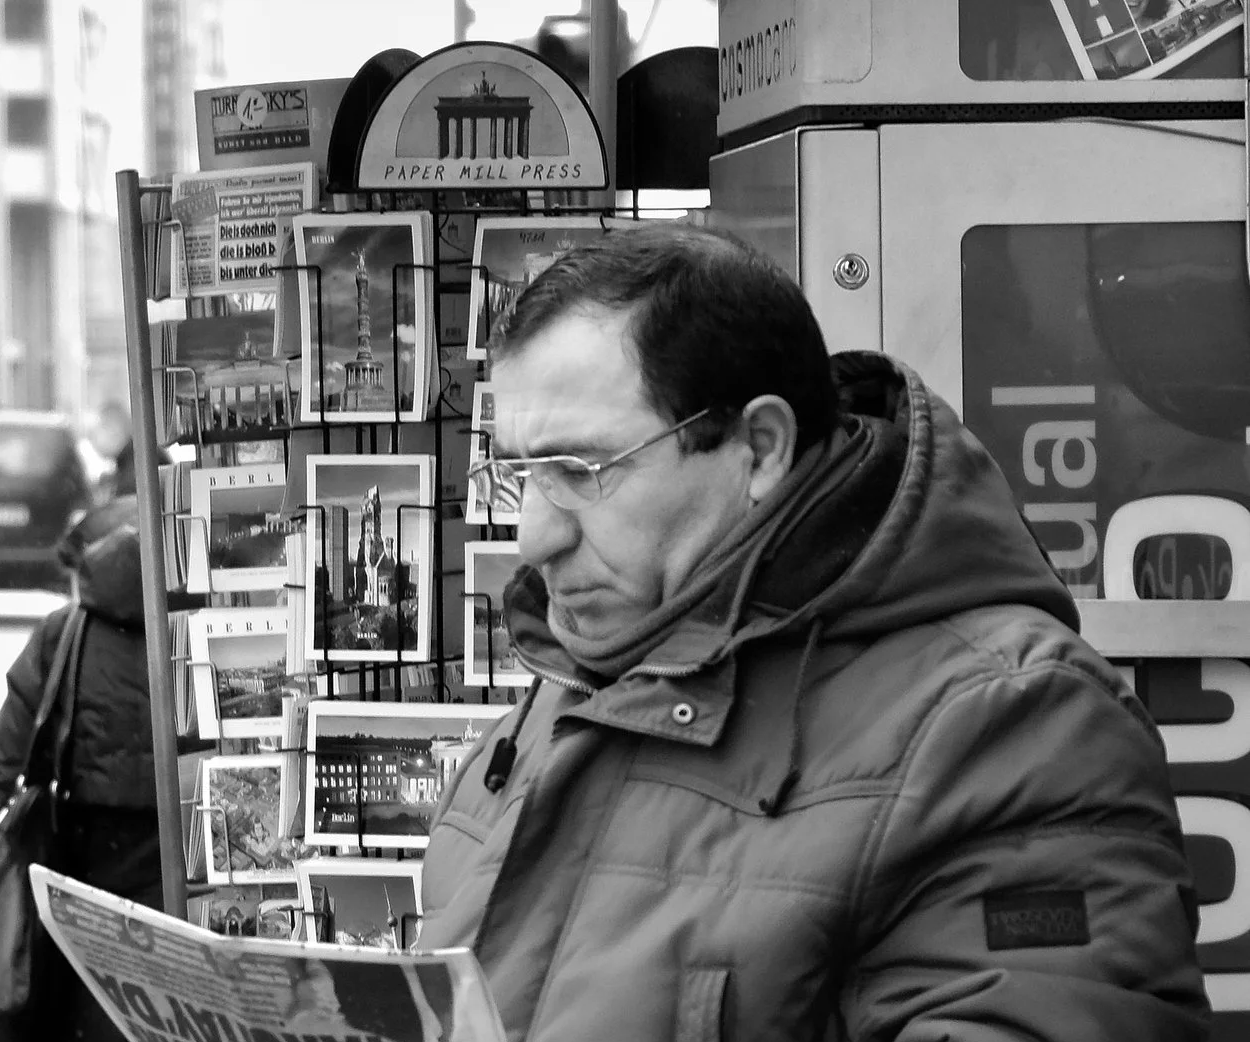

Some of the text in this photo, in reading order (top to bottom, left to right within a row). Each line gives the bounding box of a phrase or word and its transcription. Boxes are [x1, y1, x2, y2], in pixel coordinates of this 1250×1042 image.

[383, 163, 582, 182] PAPER MILL PRESS
[233, 264, 258, 278] unter
[991, 384, 1098, 598] ual
